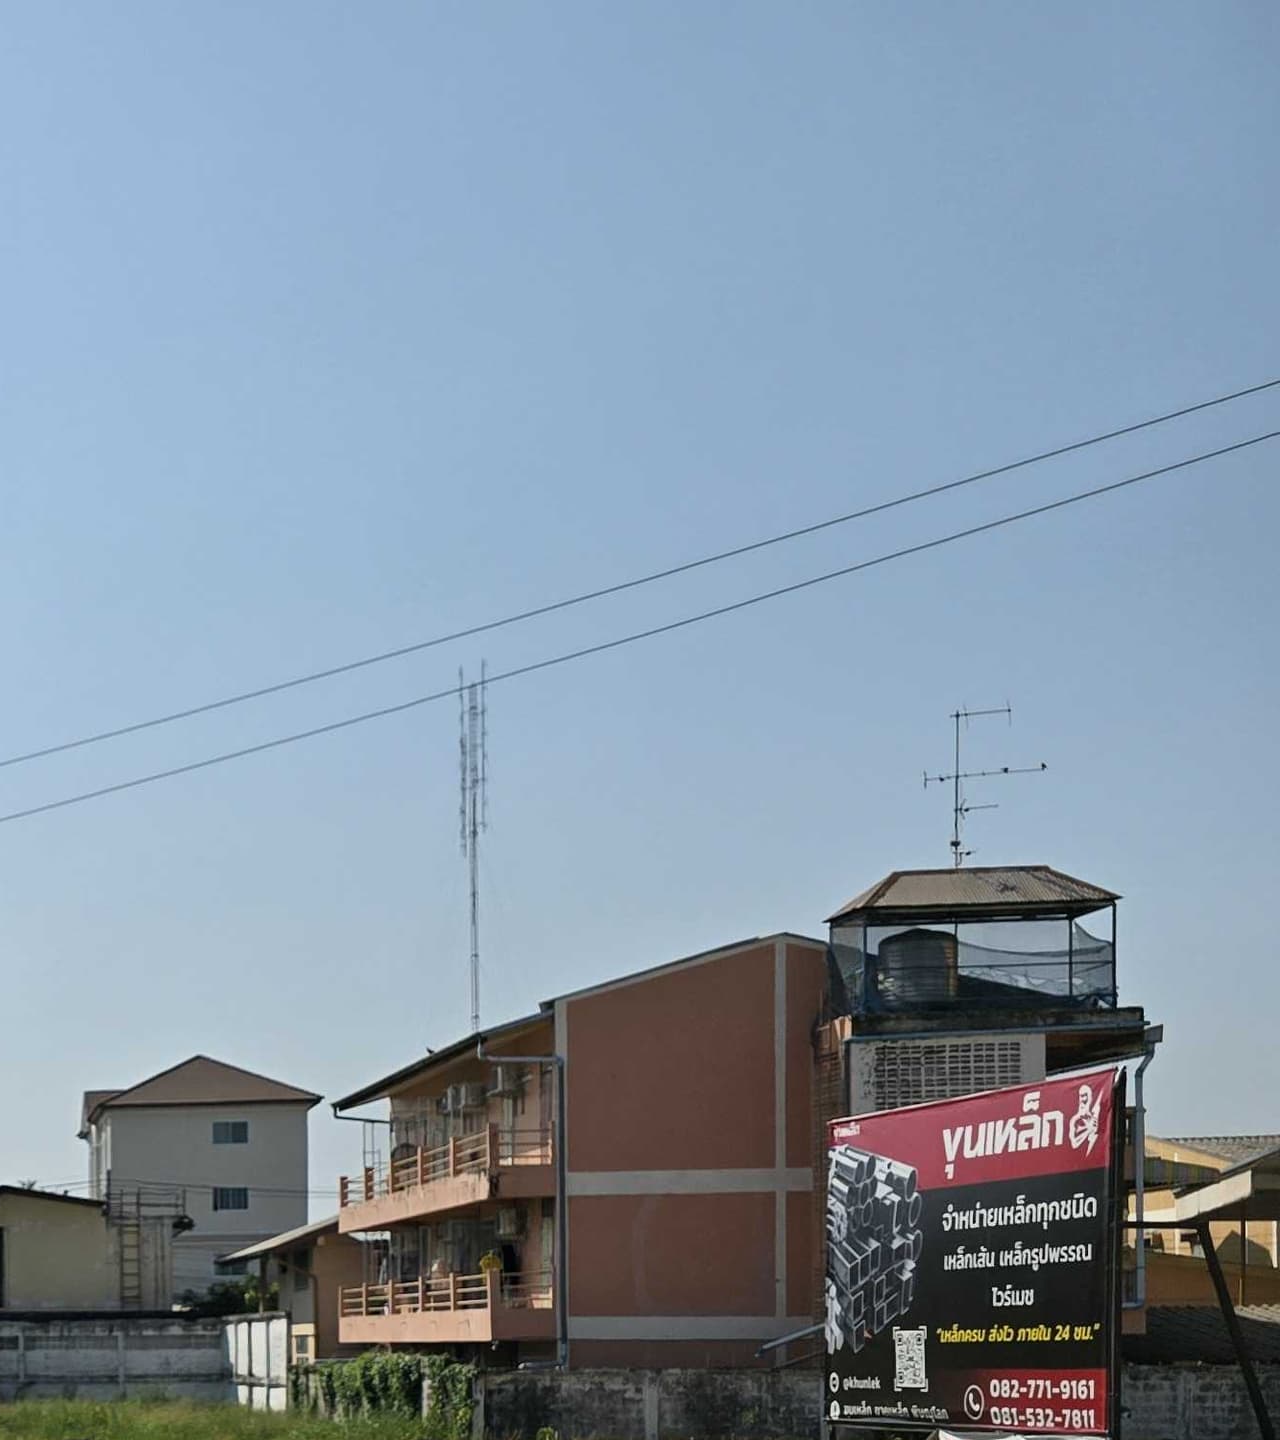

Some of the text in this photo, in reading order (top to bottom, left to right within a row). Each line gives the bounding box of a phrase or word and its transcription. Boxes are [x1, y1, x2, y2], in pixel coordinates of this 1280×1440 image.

[943, 1091, 1064, 1180] ขุนเหล็ก
[942, 1193, 1097, 1231] จำหน่ายเหล็กทุกชนิด
[943, 1241, 1092, 1271] เหล็กเส้น เหล็กรูปพรรณ
[989, 1324, 1014, 1341] ส่งไว
[1016, 1324, 1051, 1341] ภายใน
[1054, 1325, 1070, 1341] 24
[990, 1379, 1095, 1399] 082-771-9161
[990, 1406, 1095, 1429] 081-532-7811
